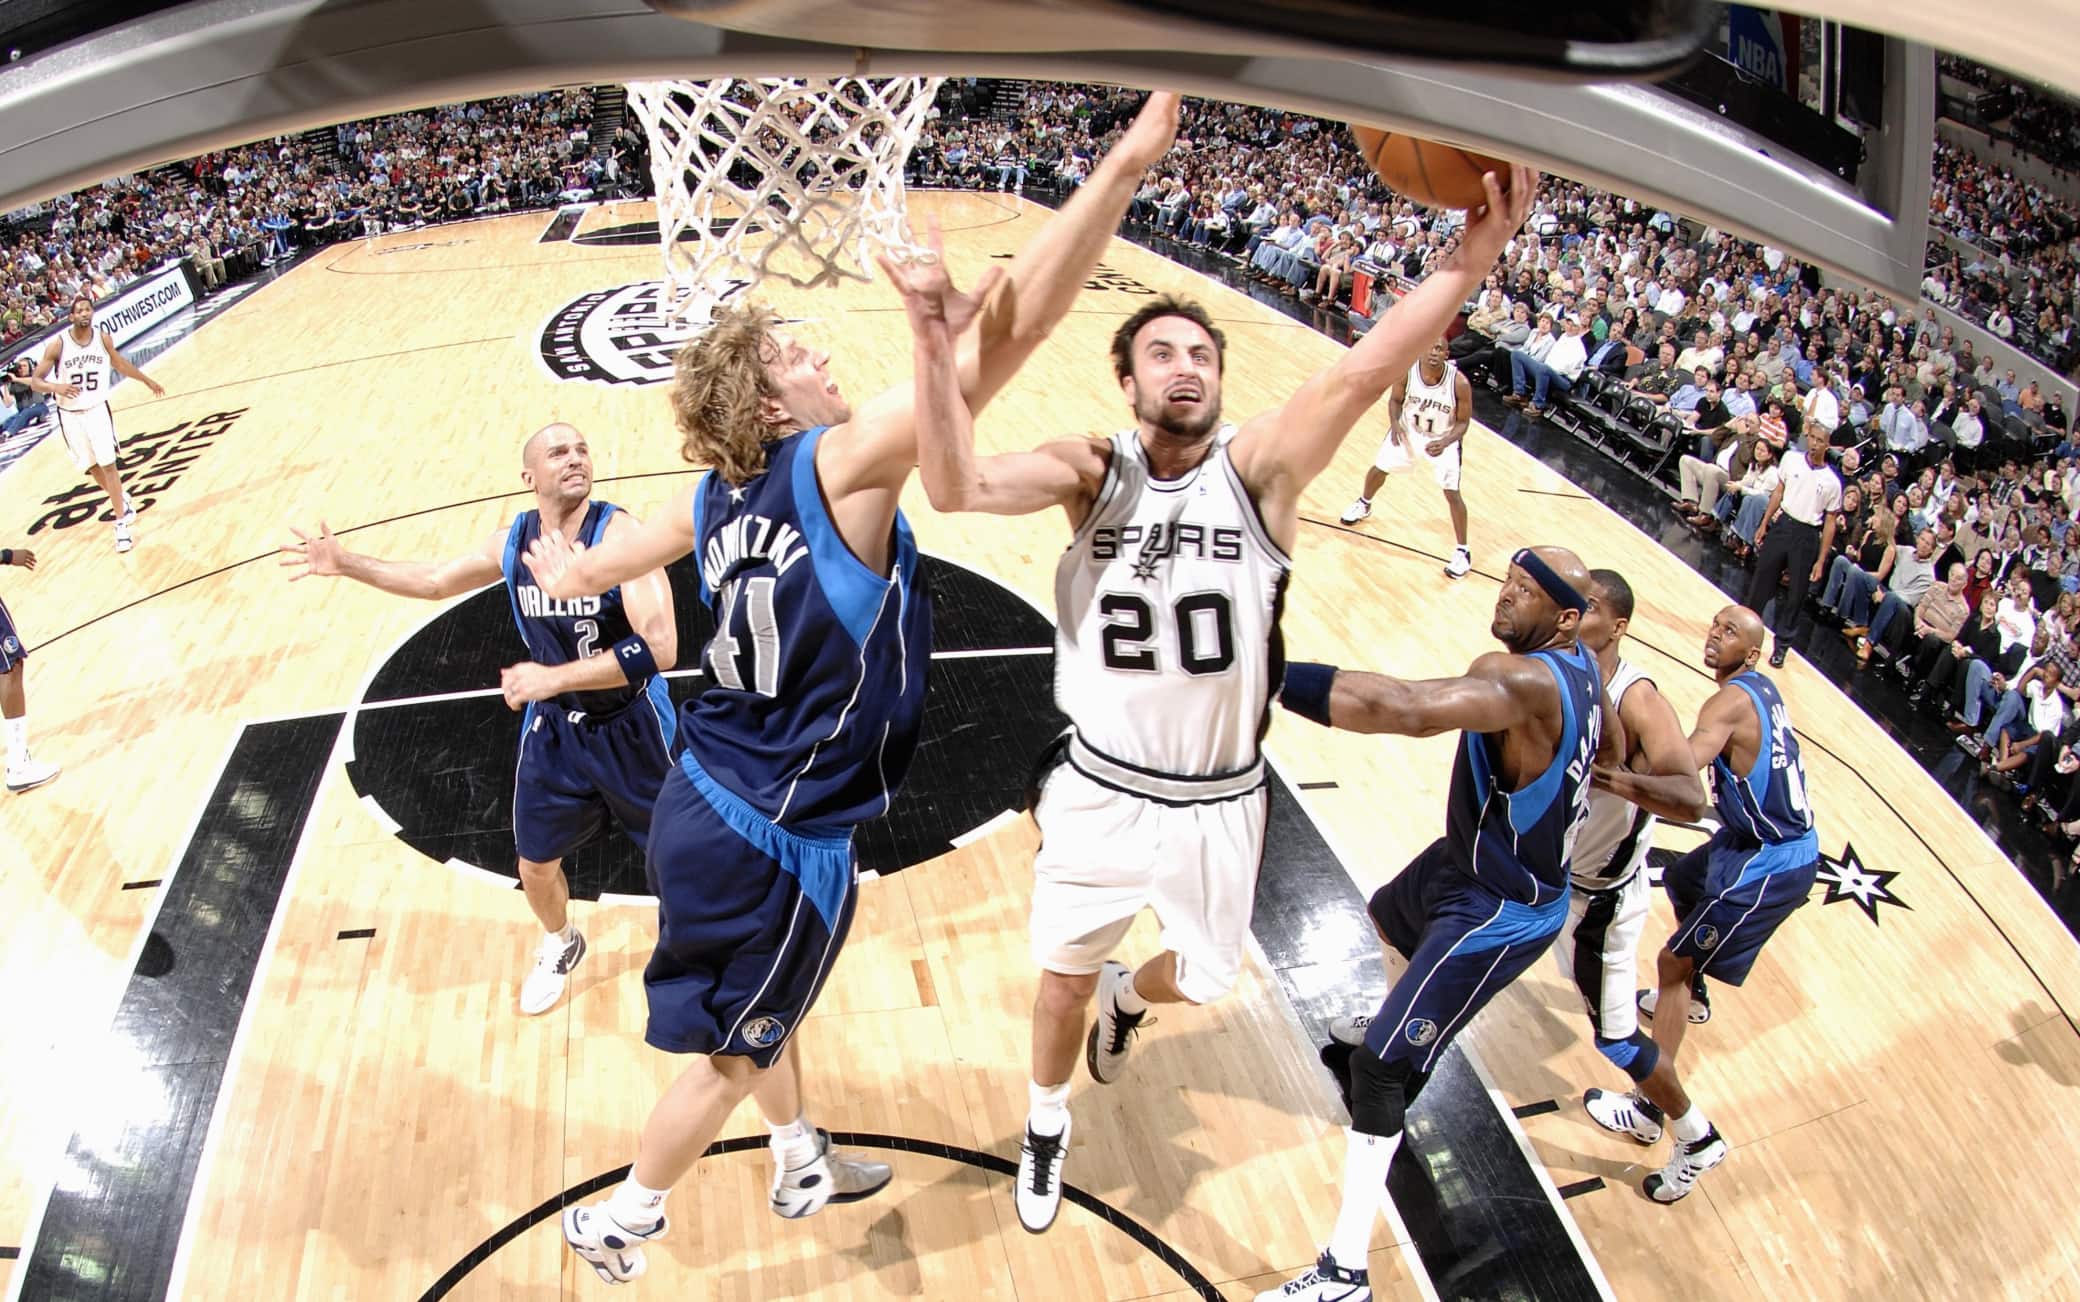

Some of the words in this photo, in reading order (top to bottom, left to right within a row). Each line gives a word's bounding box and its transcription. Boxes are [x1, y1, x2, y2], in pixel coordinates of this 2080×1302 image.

[1739, 34, 1777, 86] NBA
[97, 282, 182, 334] OUTHWEST.COM
[553, 294, 607, 342] ANTONIO
[64, 355, 103, 370] SPURS
[71, 371, 99, 391] 25
[554, 346, 591, 373] SAN
[1413, 413, 1434, 433] 11
[98, 407, 250, 522] CENTER
[1092, 520, 1244, 566] SPURS
[574, 618, 602, 662] 2
[621, 642, 642, 659] 2
[707, 577, 780, 698] 41
[1099, 589, 1237, 678] 20
